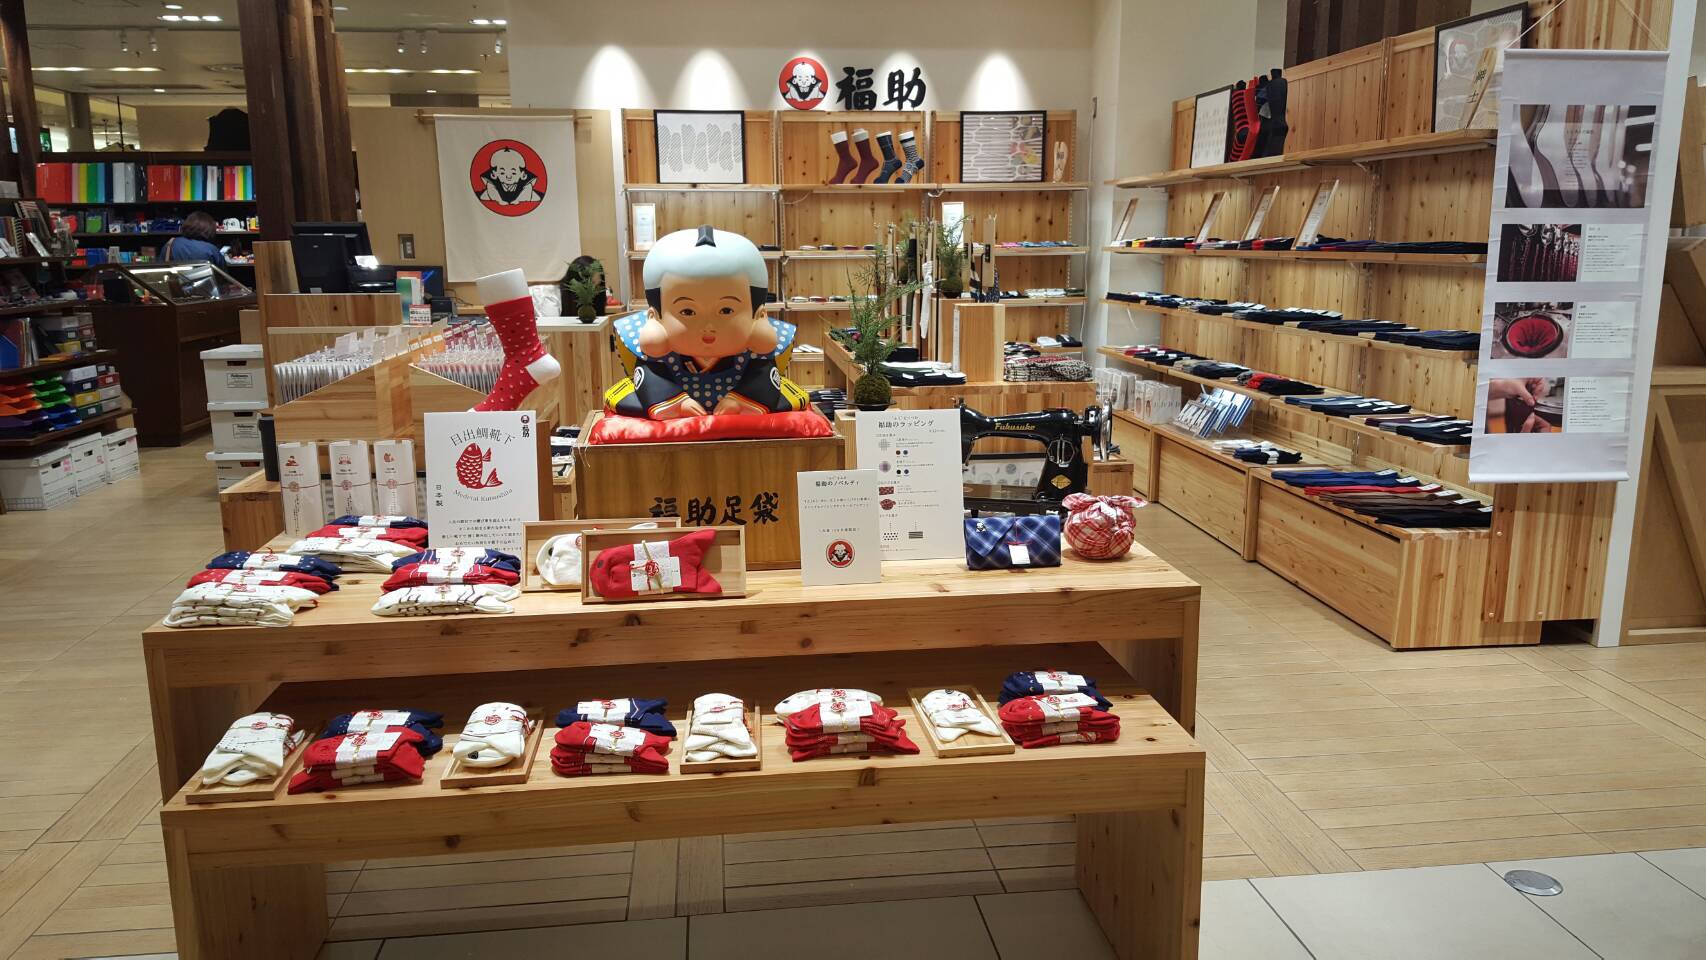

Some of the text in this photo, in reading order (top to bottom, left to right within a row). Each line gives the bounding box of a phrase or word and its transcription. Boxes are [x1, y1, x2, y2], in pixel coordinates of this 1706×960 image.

[835, 66, 926, 111] 福助
[994, 422, 1036, 431] Fukusuke
[435, 484, 444, 507] 日本製
[649, 491, 779, 526] 福助足袋
